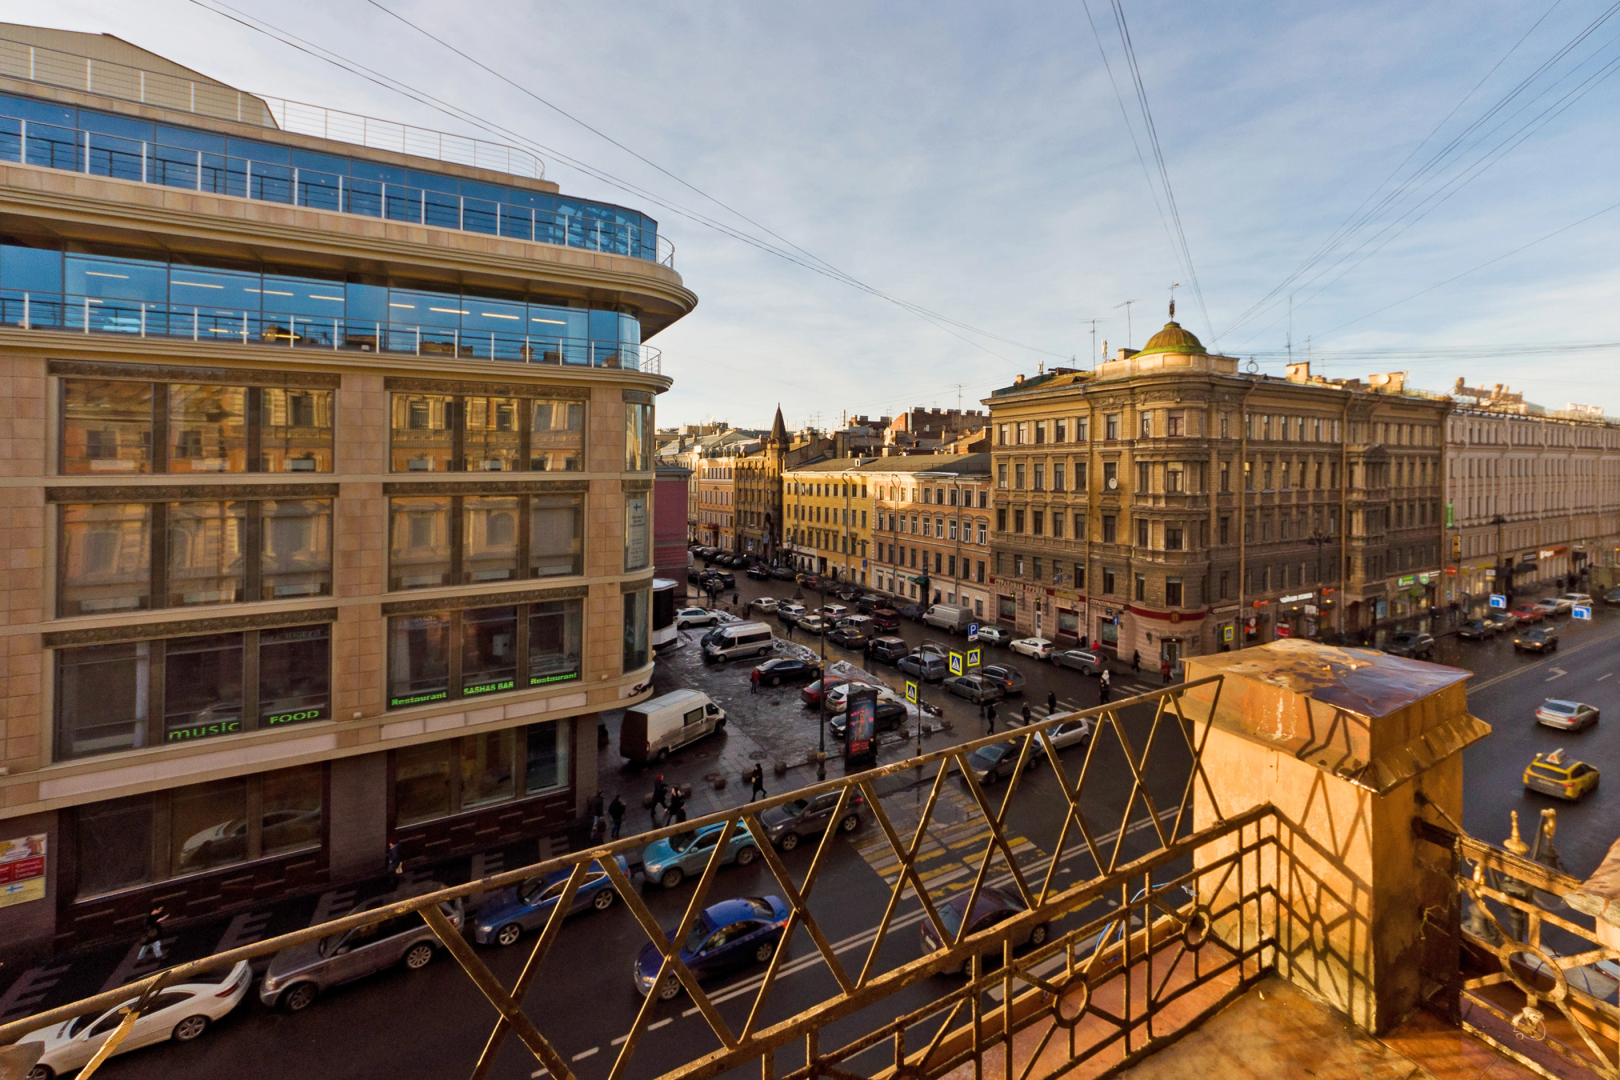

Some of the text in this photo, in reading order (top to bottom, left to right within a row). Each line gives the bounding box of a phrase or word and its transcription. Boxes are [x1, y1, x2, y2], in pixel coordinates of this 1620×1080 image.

[970, 624, 977, 635] P
[530, 672, 577, 685] Restaurant
[463, 680, 514, 696] SASHAS BAR
[391, 692, 447, 706] Restaurant
[269, 710, 320, 725] FOOD
[169, 722, 240, 740] music
